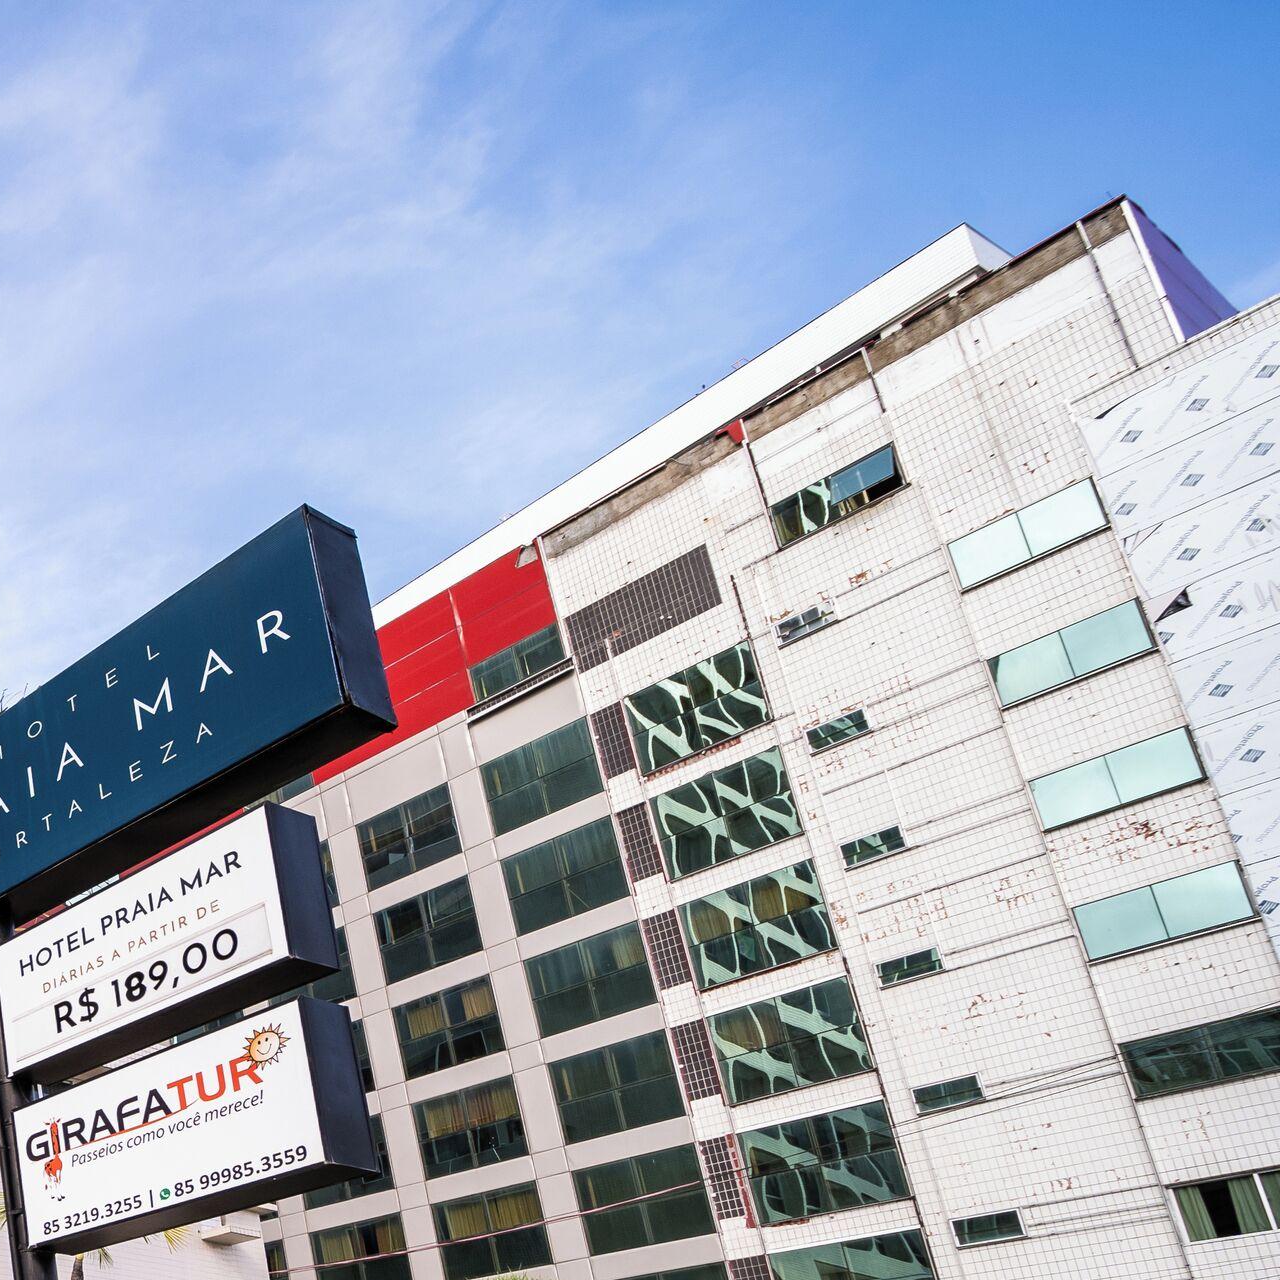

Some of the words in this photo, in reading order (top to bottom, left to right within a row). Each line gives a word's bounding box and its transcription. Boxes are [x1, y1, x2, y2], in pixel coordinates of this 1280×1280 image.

[133, 610, 291, 731] MAR
[19, 926, 95, 977] HOTEL
[101, 886, 174, 937] PRAIA
[180, 850, 242, 896] MAR
[42, 958, 105, 994] DIÁRIAS
[111, 949, 121, 961] A
[127, 916, 189, 953] PARTIR
[197, 899, 221, 921] DE
[53, 987, 100, 1034] R$
[112, 928, 239, 1009] 189,00
[26, 1056, 265, 1162] GIRAFATUR
[71, 1139, 124, 1168] Passeios
[126, 1126, 165, 1148] como
[168, 1111, 201, 1137] você
[204, 1089, 265, 1125] merece!
[43, 1218, 61, 1236] 85
[64, 1194, 143, 1231] 3219.3255
[174, 1179, 195, 1198] 85
[199, 1144, 308, 1190] 99985.3559
